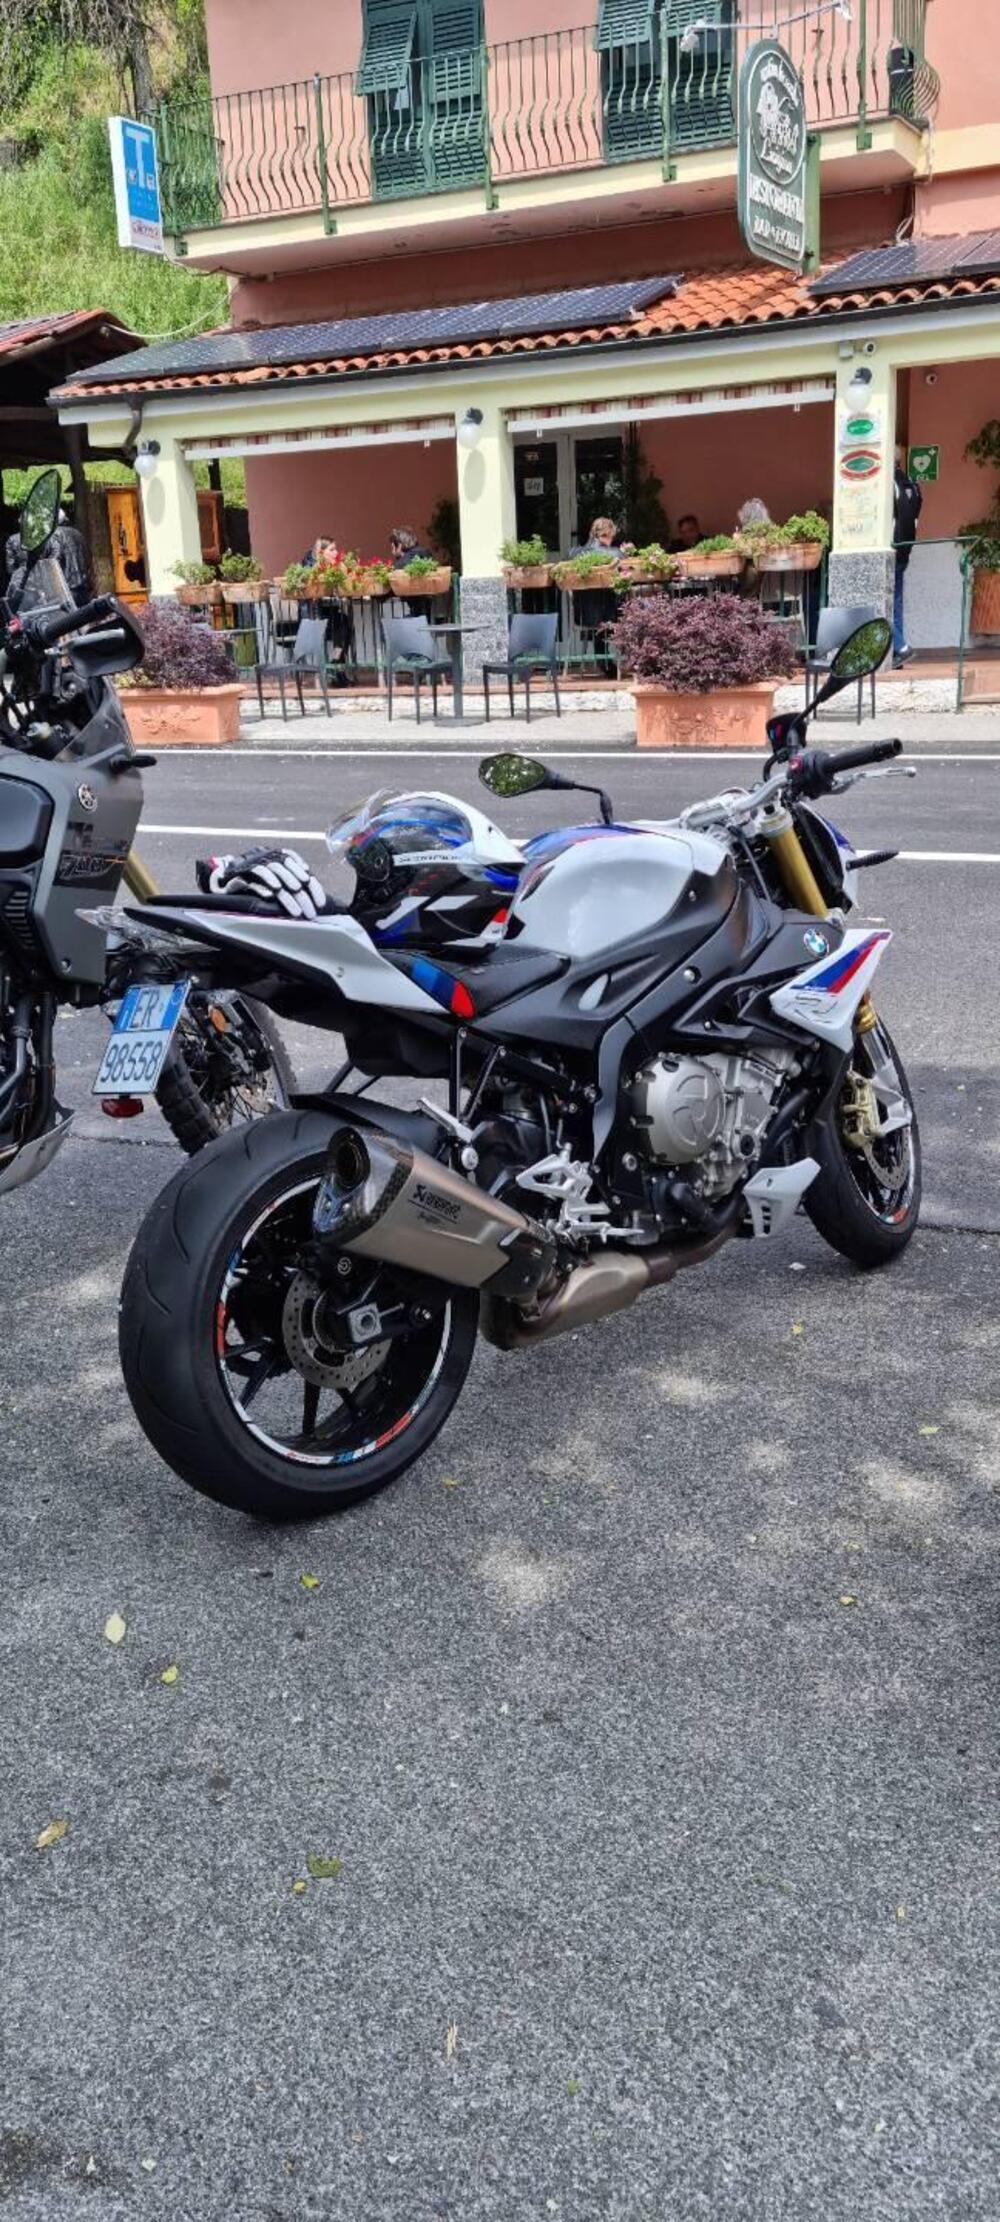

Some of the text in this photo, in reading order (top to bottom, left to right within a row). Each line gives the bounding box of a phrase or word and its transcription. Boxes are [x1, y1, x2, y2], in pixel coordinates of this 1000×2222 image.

[125, 126, 150, 189] T
[129, 987, 160, 1029] ER
[101, 1041, 163, 1082] 98558
